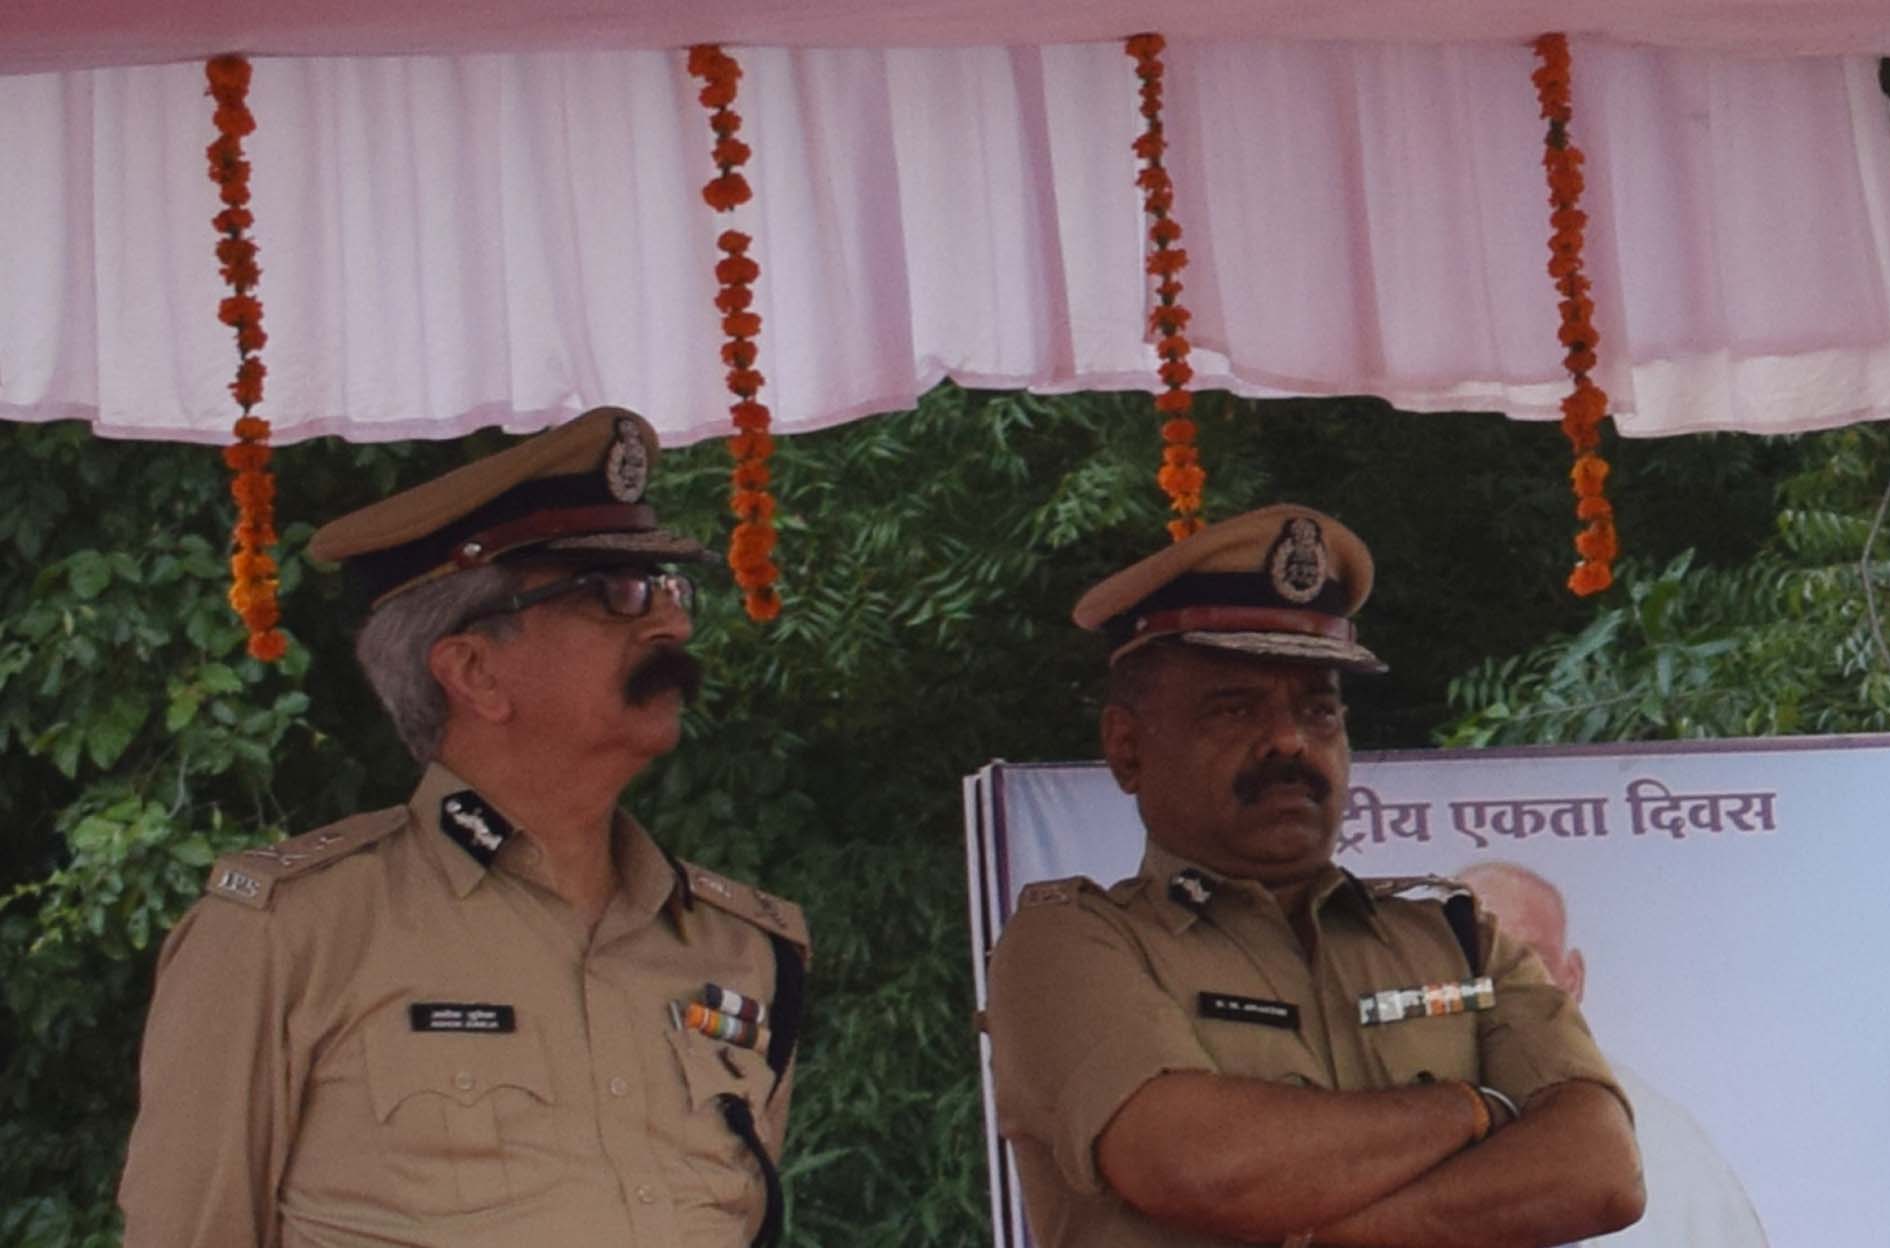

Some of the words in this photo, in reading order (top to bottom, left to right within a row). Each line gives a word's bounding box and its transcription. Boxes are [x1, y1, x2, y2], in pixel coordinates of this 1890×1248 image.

[1336, 786, 1431, 854] ट्रीय
[1450, 797, 1609, 848] एकता
[1625, 778, 1777, 838] दिवस
